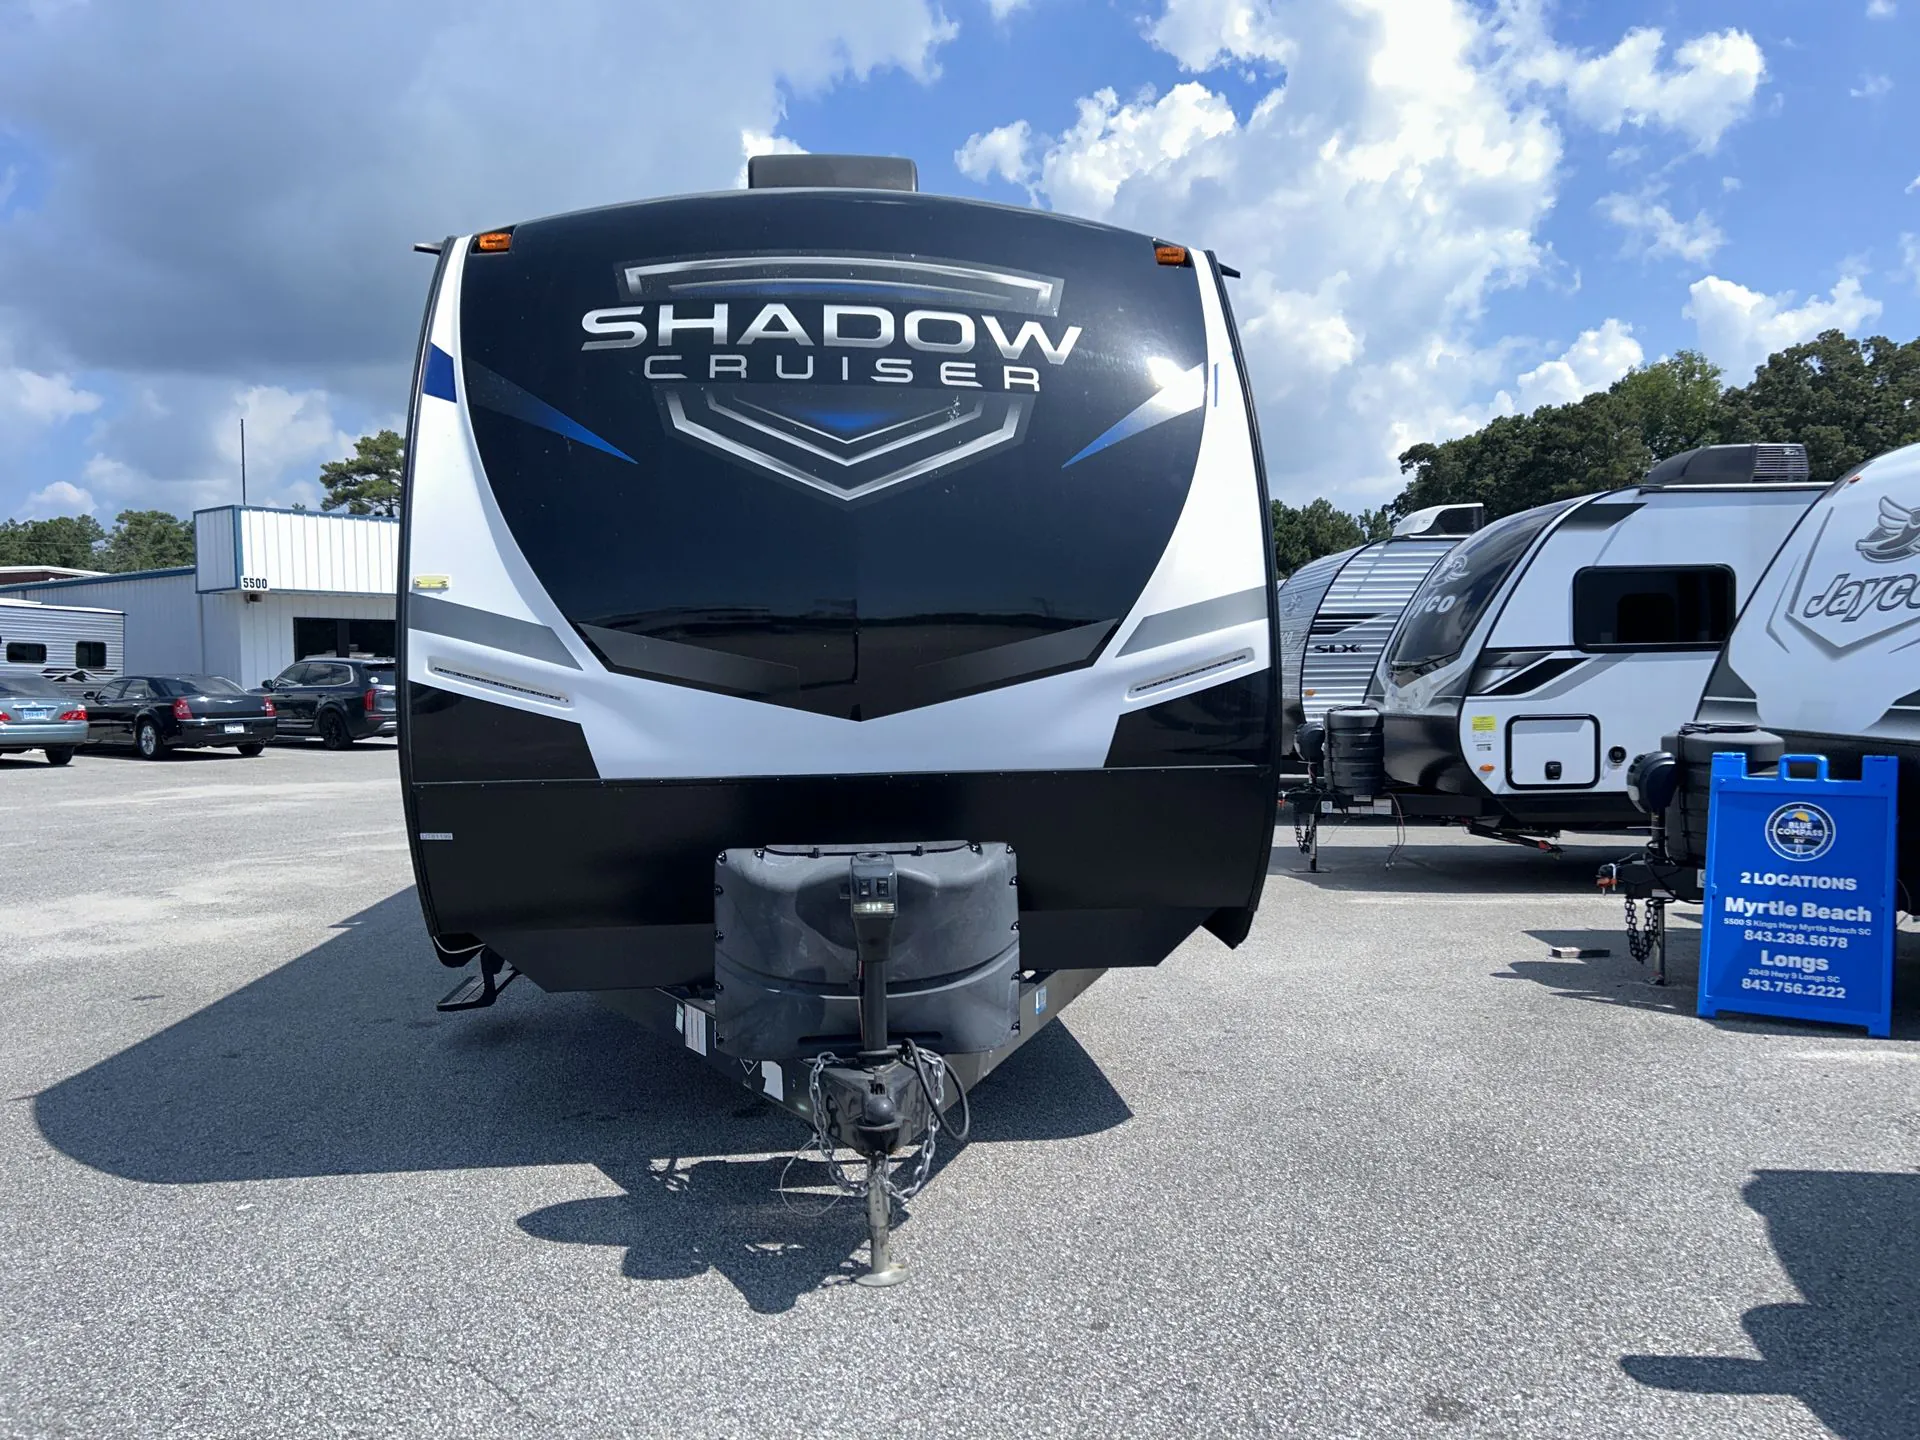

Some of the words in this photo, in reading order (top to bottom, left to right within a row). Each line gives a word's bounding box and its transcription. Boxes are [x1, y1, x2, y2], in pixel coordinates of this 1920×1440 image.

[581, 303, 1083, 366] SHADOW
[644, 354, 1041, 392] CRUISER
[243, 577, 268, 589] 5500
[1777, 828, 1824, 837] COMPASS
[1788, 821, 1812, 830] BLUE
[1740, 872, 1751, 884] 2
[1754, 872, 1858, 891] LOCATIONS
[1725, 897, 1798, 917] Myrtle
[1802, 901, 1872, 922] Beach
[1724, 917, 1745, 926] 5500
[1753, 920, 1778, 929] Kings
[1779, 922, 1797, 931] Hwy
[1799, 923, 1827, 933] Myrtle
[1829, 925, 1857, 935] Beach
[1857, 928, 1872, 936] SC
[1744, 929, 1848, 949] 843.238.5678
[1761, 949, 1829, 973] Longs
[1771, 970, 1790, 980] Hwy
[1798, 973, 1826, 982] Longs
[1827, 975, 1841, 983] SC
[1741, 978, 1846, 999] 843.756.2222
